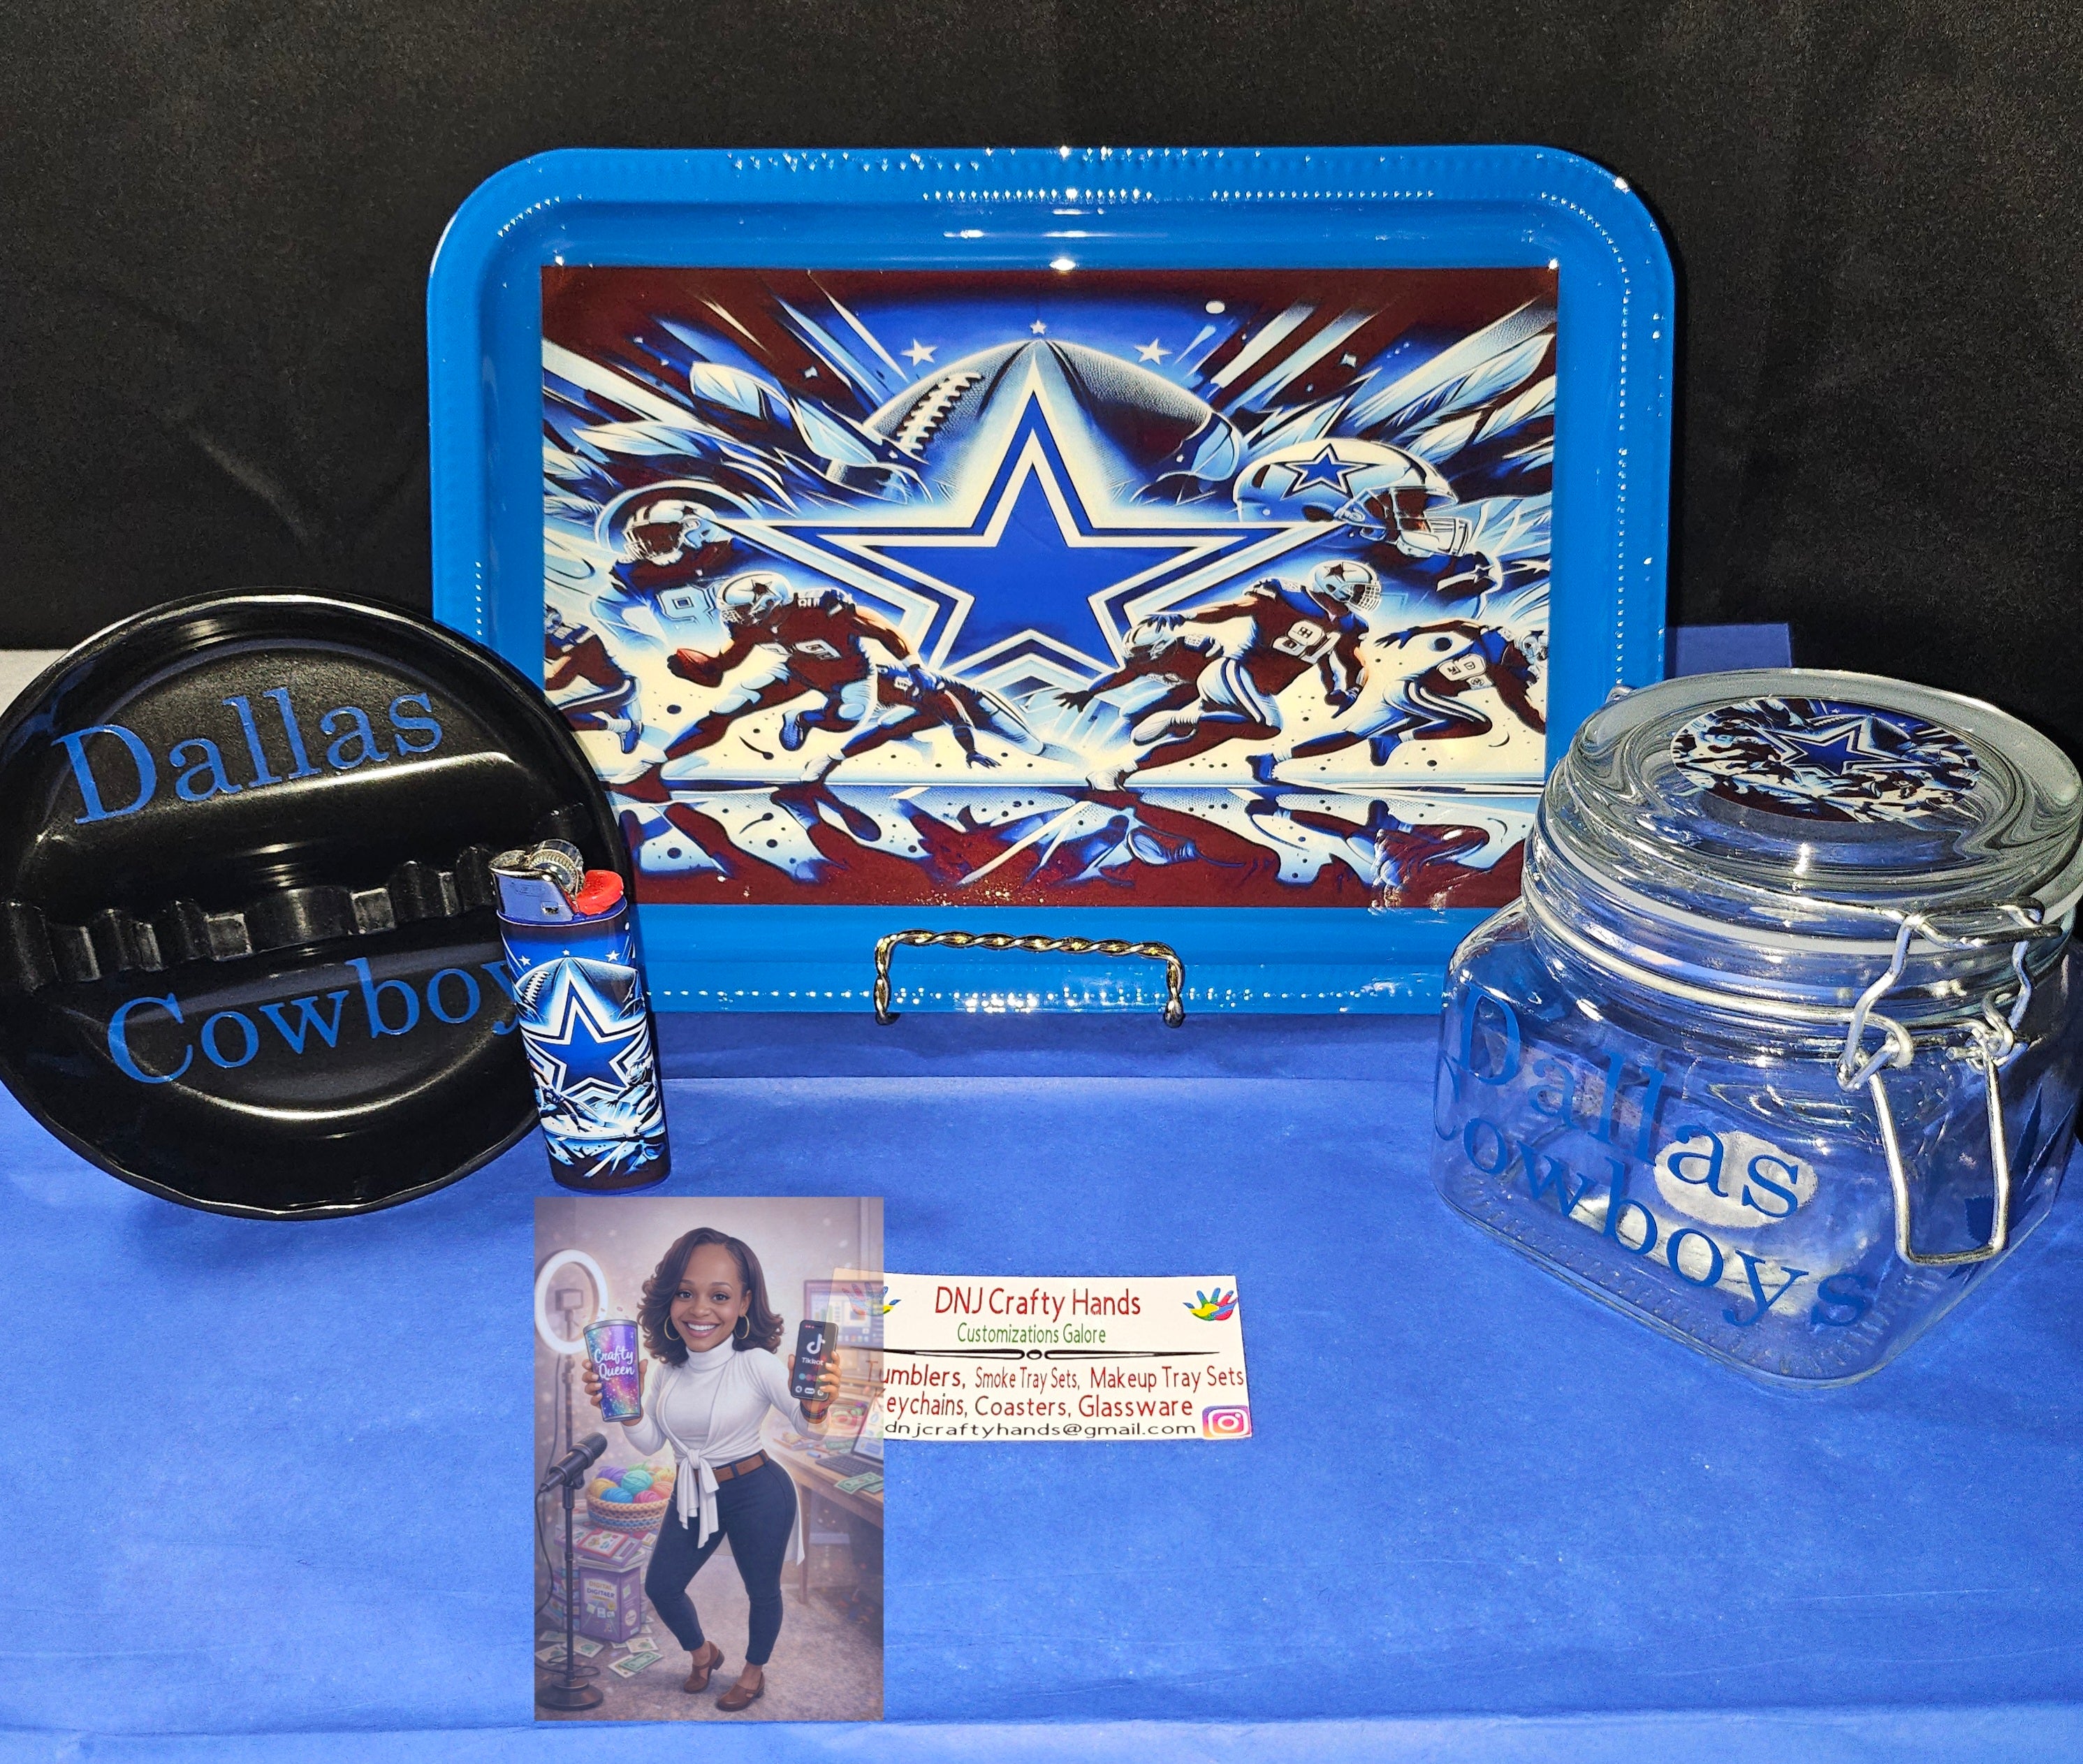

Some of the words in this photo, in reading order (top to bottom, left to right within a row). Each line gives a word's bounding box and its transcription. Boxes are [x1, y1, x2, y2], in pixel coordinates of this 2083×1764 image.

[51, 687, 444, 824] Dallas
[106, 957, 519, 1086] Cowboy
[1452, 981, 1799, 1218] Dallas
[935, 1286, 984, 1314] DNJ
[988, 1287, 1066, 1322] Crafty
[1072, 1288, 1141, 1315] Hands
[957, 1322, 1060, 1343] Customizations
[1062, 1322, 1106, 1343] Galore
[975, 1366, 1016, 1389] Smoke
[1019, 1366, 1048, 1395] Tray
[1051, 1366, 1080, 1391] Sets,
[1090, 1366, 1157, 1393] Makeup
[1161, 1365, 1201, 1394] Tray
[1206, 1365, 1245, 1387] Sets
[974, 1394, 1072, 1419] Coasters,
[1079, 1394, 1193, 1418] Glassware
[884, 1421, 1196, 1439] dnjcraftyhands@gmail.com
